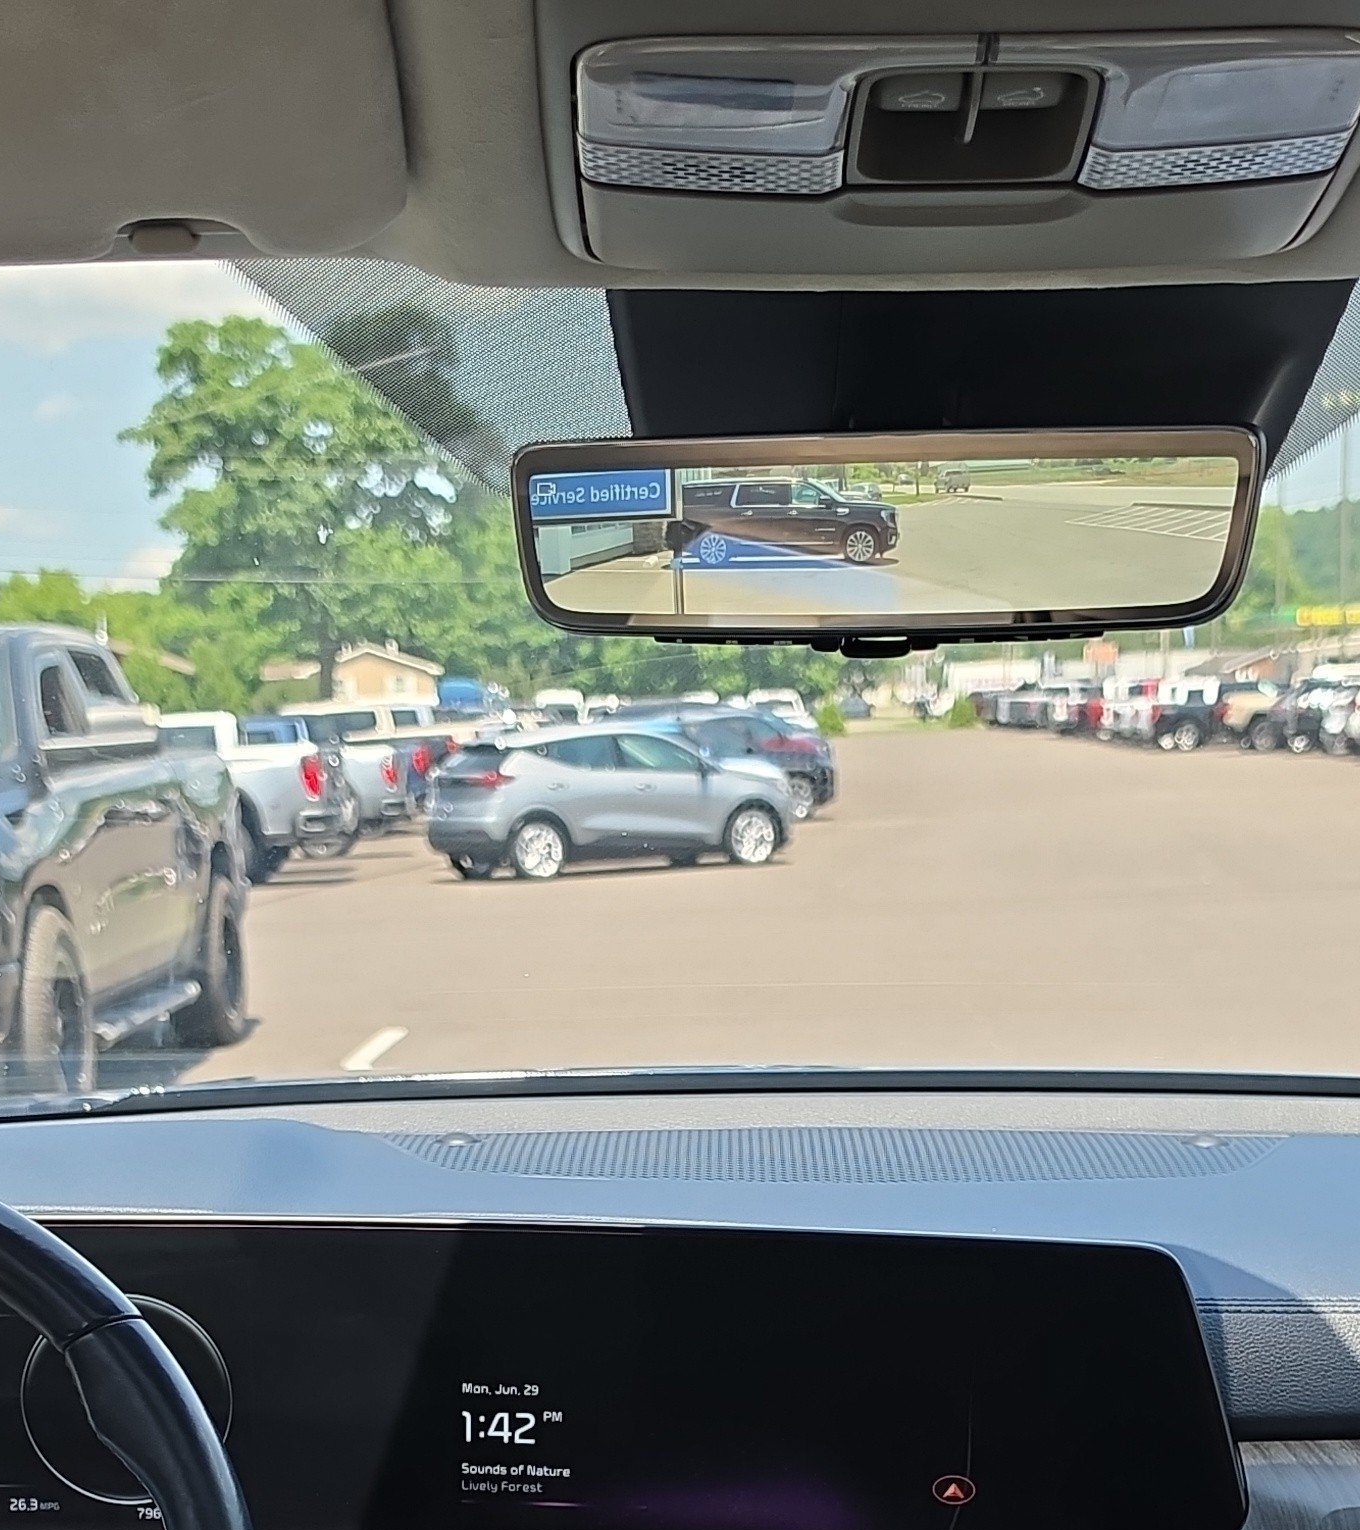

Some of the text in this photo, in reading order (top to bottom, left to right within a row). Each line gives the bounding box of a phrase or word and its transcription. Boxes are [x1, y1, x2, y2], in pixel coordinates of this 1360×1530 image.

[523, 1384, 539, 1396] 29
[461, 1410, 563, 1445] 1:42 PM
[461, 1463, 571, 1478] Sounds of Nature
[461, 1480, 543, 1493] Lively Forest
[9, 1498, 38, 1512] 26.3
